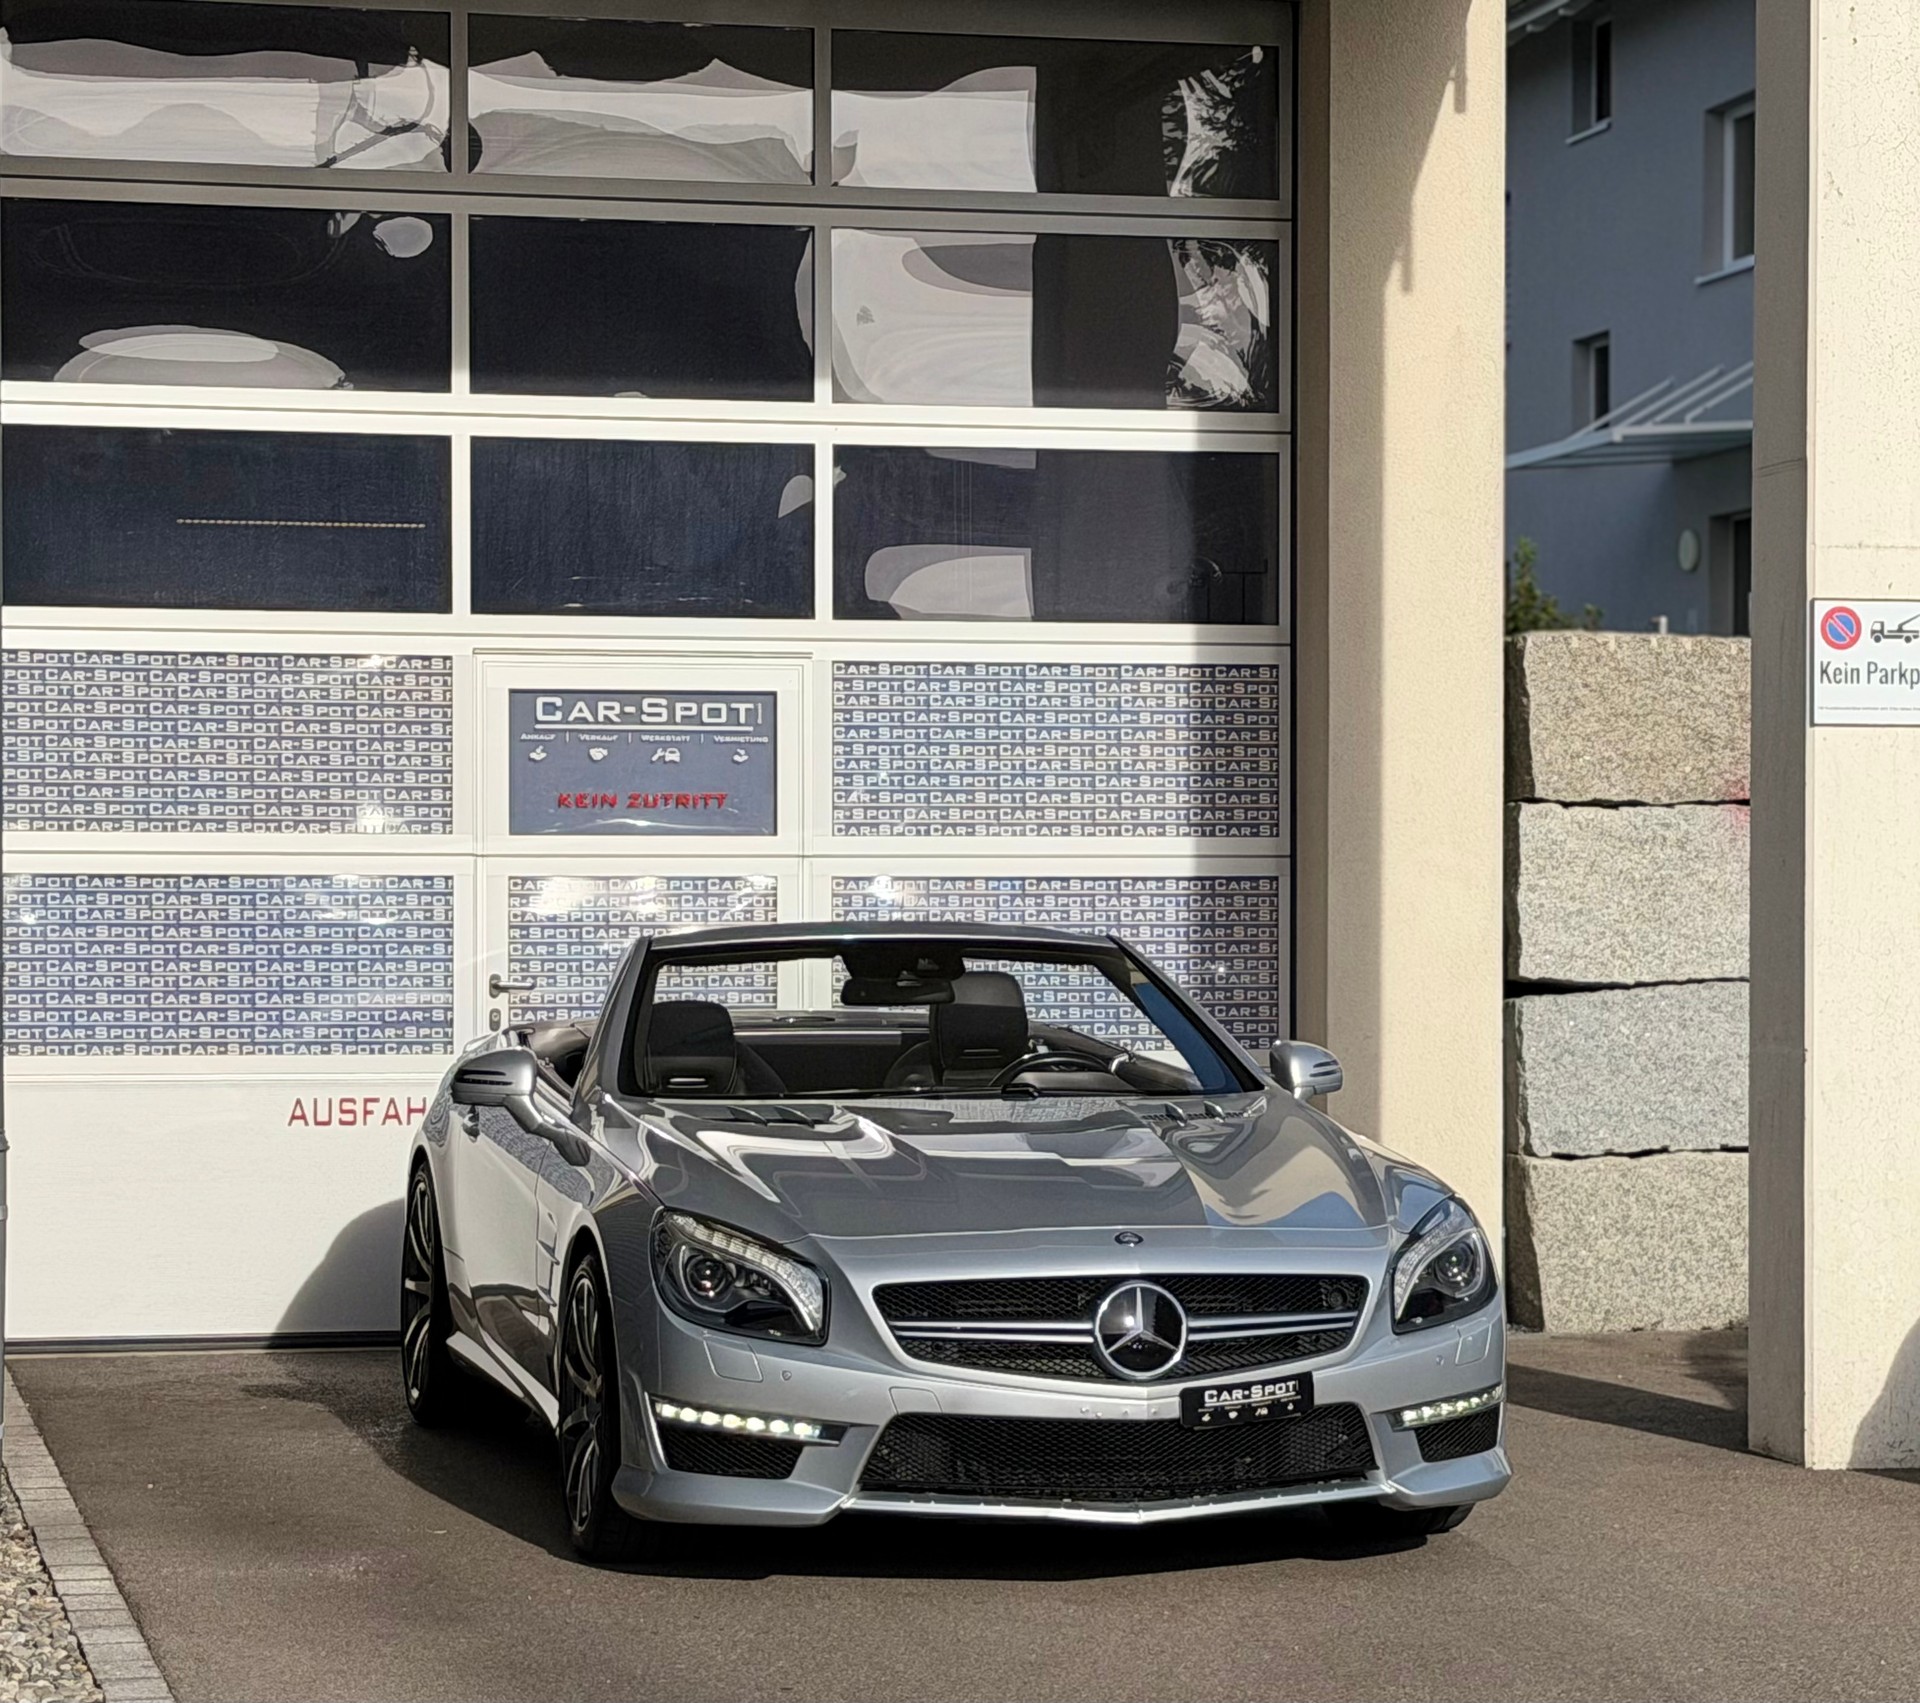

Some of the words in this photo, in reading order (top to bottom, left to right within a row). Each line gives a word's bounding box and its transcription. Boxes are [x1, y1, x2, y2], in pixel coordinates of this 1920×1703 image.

[1820, 660, 1860, 684] Kein
[558, 792, 618, 808] KEIN
[626, 792, 728, 809] ZUTRITT
[287, 1097, 427, 1126] AUSFAH
